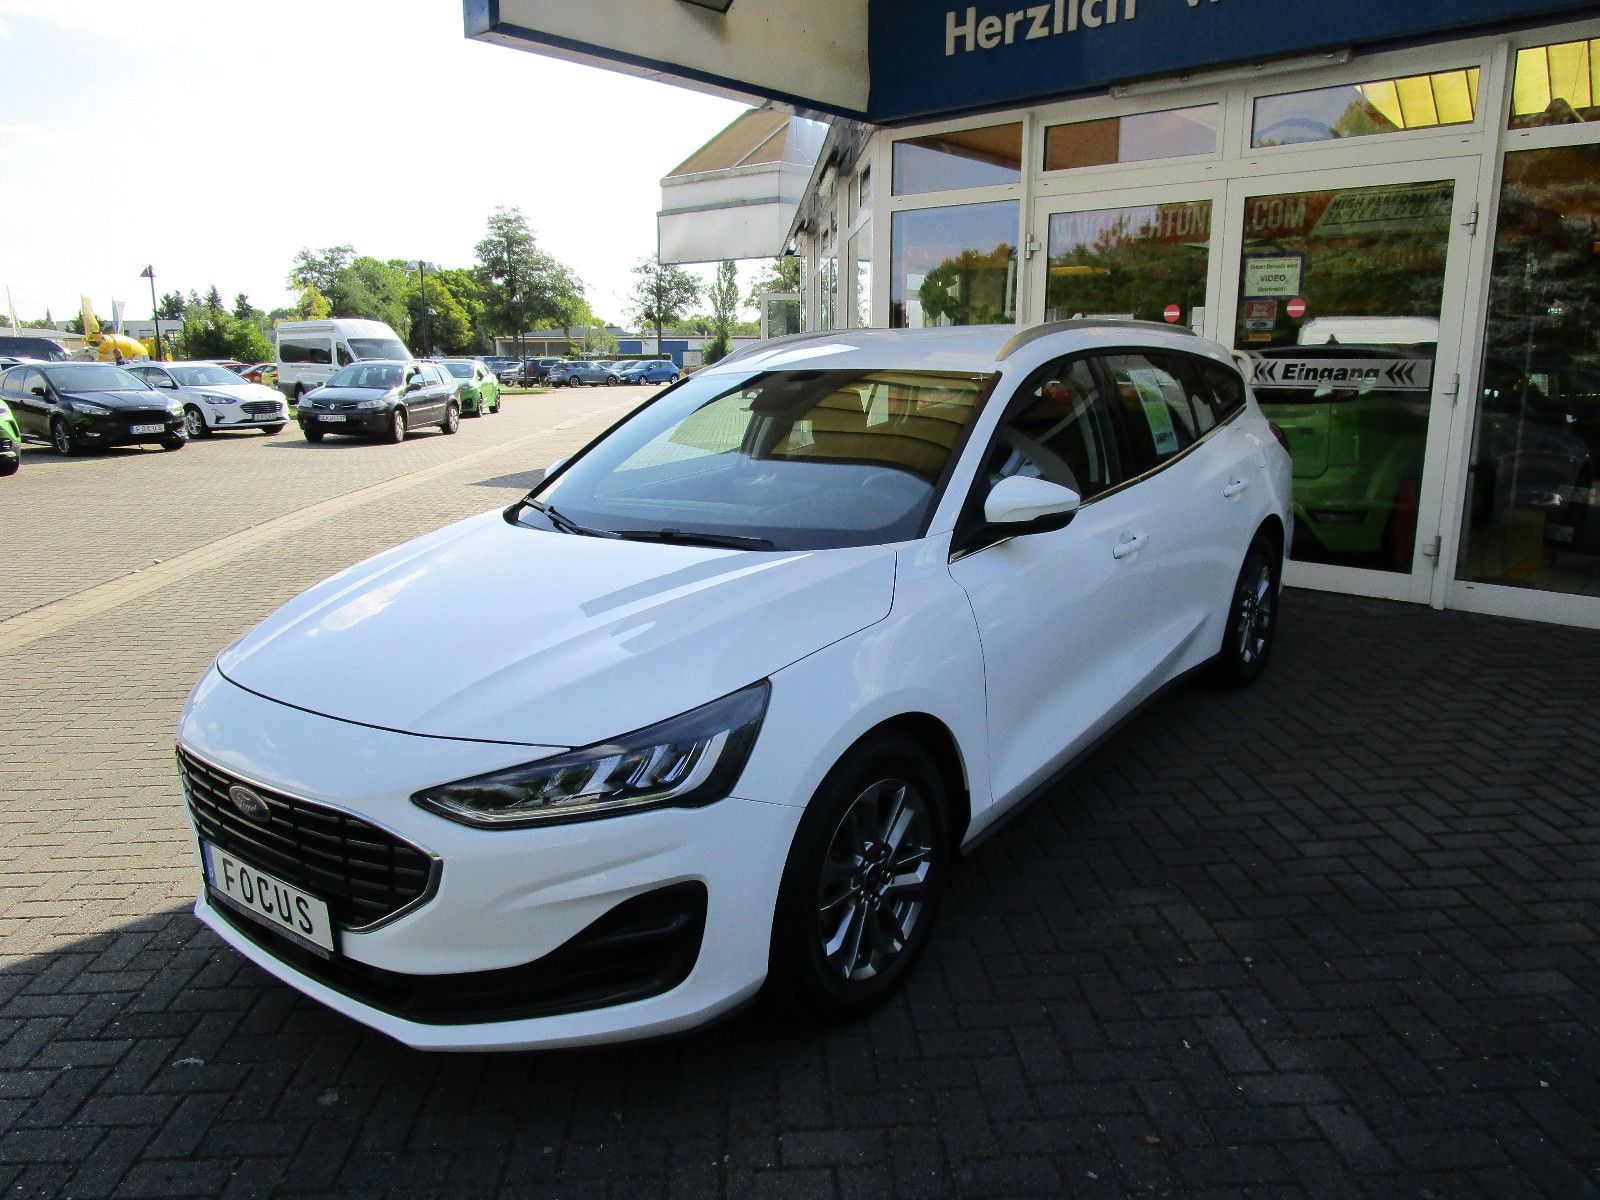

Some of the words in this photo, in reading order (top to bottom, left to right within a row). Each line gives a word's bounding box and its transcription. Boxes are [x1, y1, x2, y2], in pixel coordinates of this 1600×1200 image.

[1281, 362, 1381, 383] Eingang
[135, 424, 162, 432] FOCUS
[222, 857, 314, 935] FOCUS
